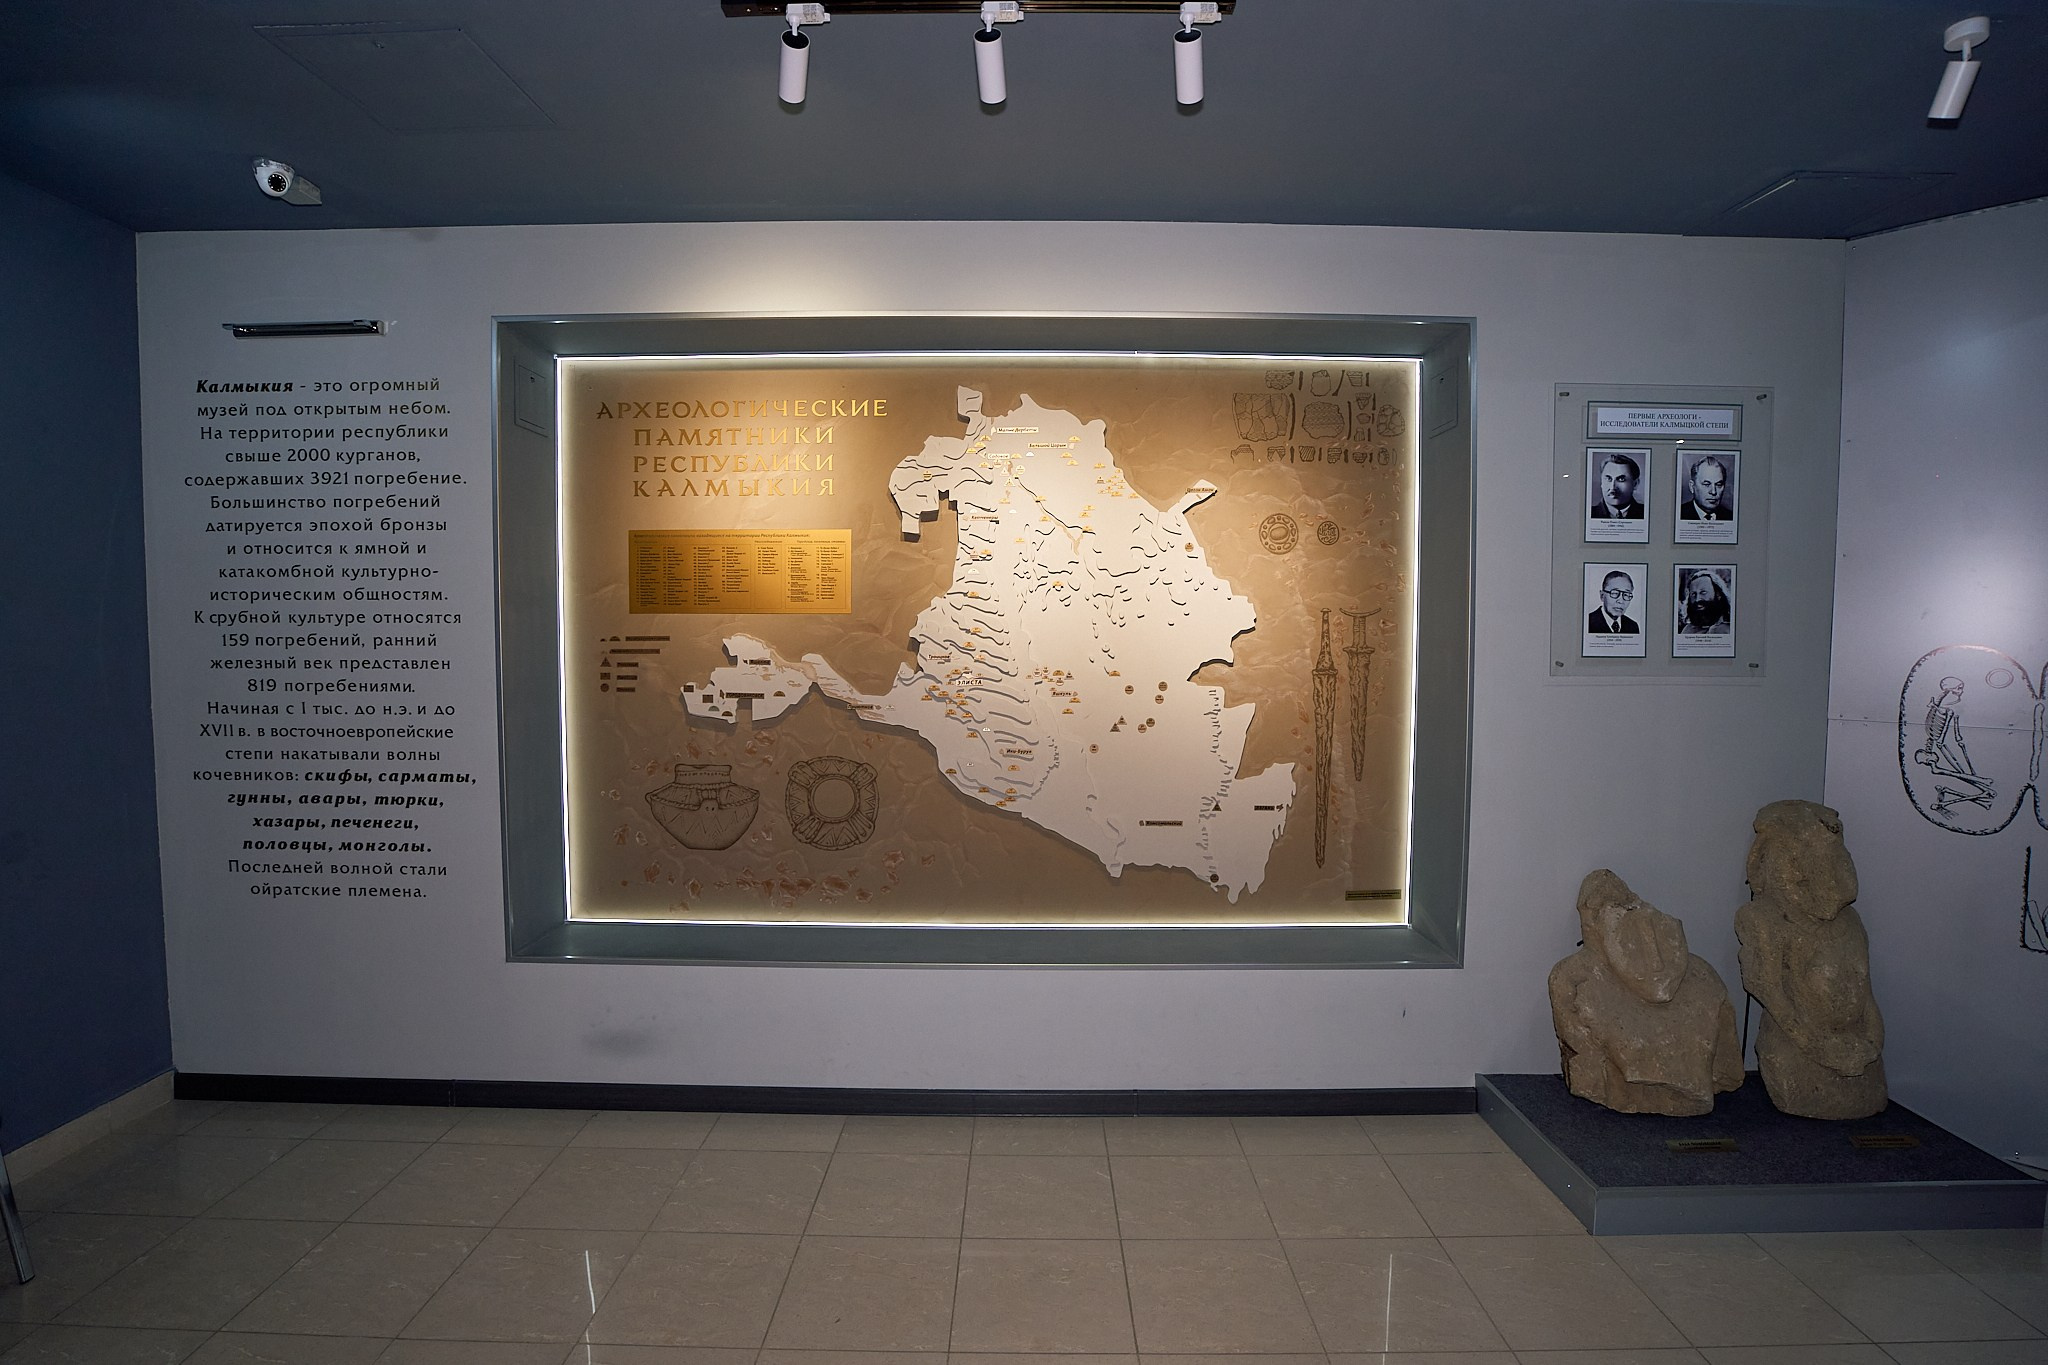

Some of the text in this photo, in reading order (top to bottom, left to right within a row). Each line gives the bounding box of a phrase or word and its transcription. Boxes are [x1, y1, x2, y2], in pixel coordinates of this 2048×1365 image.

[196, 379, 294, 394] Калмыкия
[313, 381, 343, 393] это
[349, 377, 440, 396] огромный
[197, 400, 451, 420] музей под открытым небом.
[596, 398, 888, 420] АРХЕОЛОГИЧЕСКИЕ
[200, 423, 448, 443] На территории республики
[1660, 421, 1705, 429] КАЛМЫЦКОЙ
[633, 426, 835, 446] ПАМЯТНИКИ
[225, 447, 421, 466] свыше 2000 курганов,
[633, 453, 834, 473] РЕСПУБЛИКИ
[184, 470, 467, 490] содержавших 3921 погребение.
[633, 478, 835, 498] КАЛМЫКИЯ
[210, 493, 441, 512] Большинство погребений
[205, 517, 447, 536] датируется эпохой бронзы
[226, 540, 427, 555] и относится к ямной и
[218, 564, 439, 582] катакомбной культурно-
[209, 586, 449, 605] историческим общностям.
[194, 610, 462, 628] К срубной культуре относятся
[221, 632, 437, 651] 159 погребений, ранний
[209, 655, 451, 673] железный век представлен
[247, 678, 416, 696] 819 погребениями.
[207, 701, 279, 715] Начиная
[285, 704, 295, 715] с
[312, 704, 349, 715] тыс.
[354, 705, 376, 716] до
[382, 705, 413, 716] н.э.
[417, 705, 427, 716] и
[433, 705, 456, 716] до
[238, 727, 251, 737] в.
[257, 727, 266, 737] в
[270, 724, 454, 742] восточноевропейские
[225, 749, 440, 761] степи накатывали волны
[193, 768, 477, 786] кочевников: скифы, сарматы,
[227, 793, 444, 809] гунны, авары, тюрки,
[252, 817, 419, 832] хазары, печенеги,
[242, 840, 432, 854] половцы, монголы.
[228, 859, 447, 876] Последней волной стали
[250, 882, 427, 899] ойратские племена.
